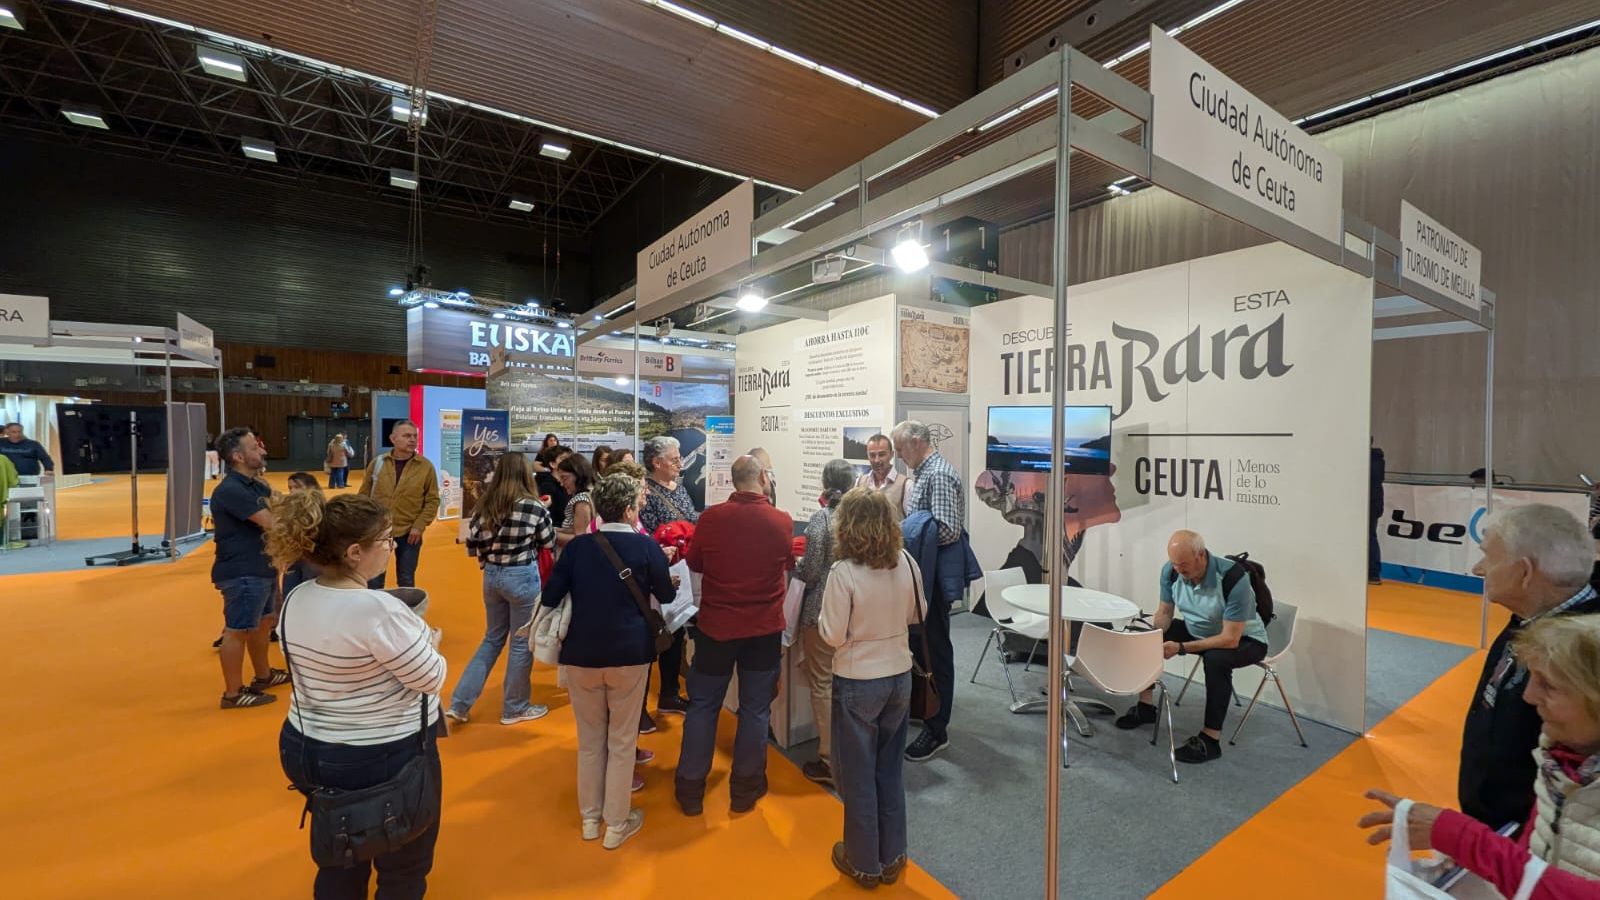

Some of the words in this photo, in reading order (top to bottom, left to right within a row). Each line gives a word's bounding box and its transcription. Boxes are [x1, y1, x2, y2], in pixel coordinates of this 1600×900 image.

[1189, 72, 1248, 137] Ciudad
[1253, 114, 1323, 183] Autónoma
[1232, 151, 1250, 189] de
[1256, 166, 1296, 212] Ceuta
[648, 240, 675, 270] Ciudad
[677, 209, 730, 255] Autónoma
[1416, 220, 1457, 263] PATRONATO
[1458, 247, 1468, 268] DE
[666, 267, 678, 288] de
[679, 255, 707, 281] Ceuta
[1406, 247, 1439, 283] TURISMO
[1440, 267, 1450, 288] DE
[1450, 271, 1475, 298] MELILLA
[1233, 289, 1291, 312] ESTA
[469, 321, 575, 357] EUSKA
[831, 329, 853, 342] HASTA
[1002, 323, 1073, 346] DESCUBE
[1112, 312, 1295, 421] Rara
[760, 367, 790, 401] Rara
[468, 423, 500, 456] Yes
[1134, 456, 1225, 501] CEUTA
[1236, 459, 1281, 475] Menos
[1236, 475, 1251, 488] de
[1254, 475, 1267, 489] lo
[1236, 489, 1281, 506] mismo.
